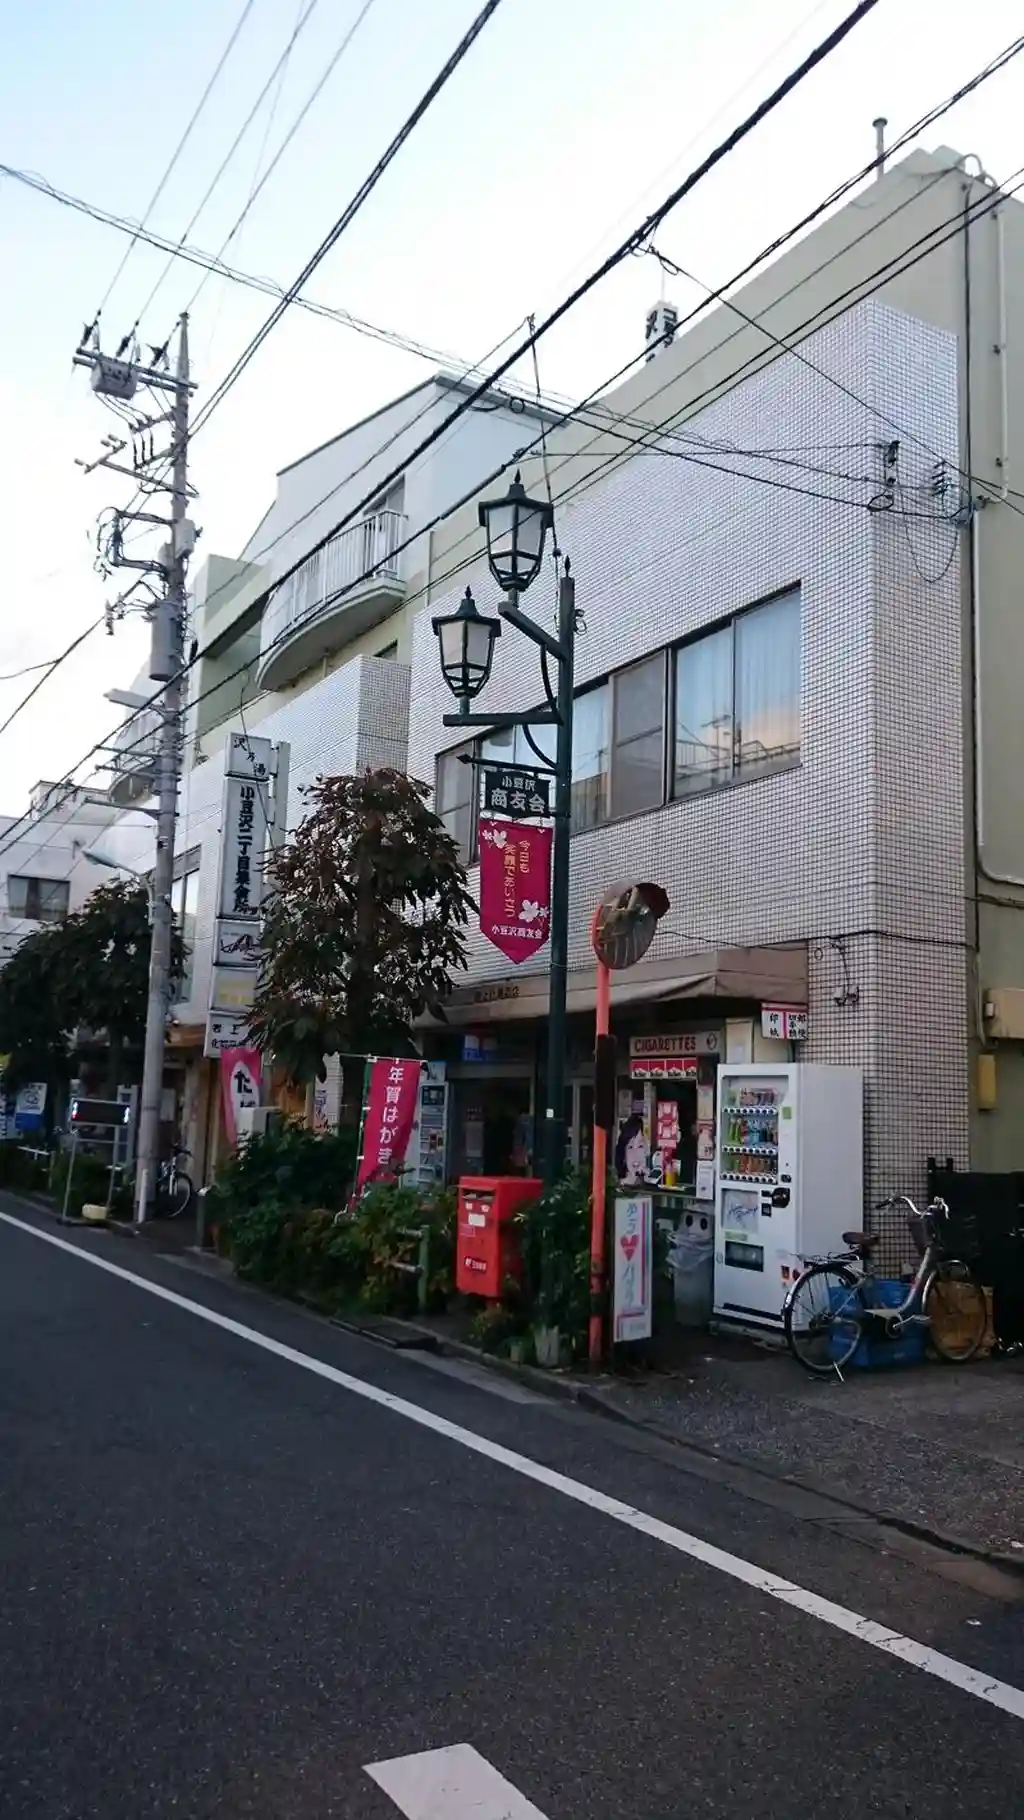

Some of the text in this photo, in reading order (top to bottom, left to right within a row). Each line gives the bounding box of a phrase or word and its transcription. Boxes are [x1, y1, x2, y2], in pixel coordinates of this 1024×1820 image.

[502, 775, 537, 792] 小豆沢
[490, 788, 546, 814] 商友会
[518, 840, 531, 874] 今日も
[491, 924, 543, 939] 小豆沢商友会
[634, 1036, 696, 1052] CIGARETTES
[378, 1066, 405, 1165] 年賀はがき
